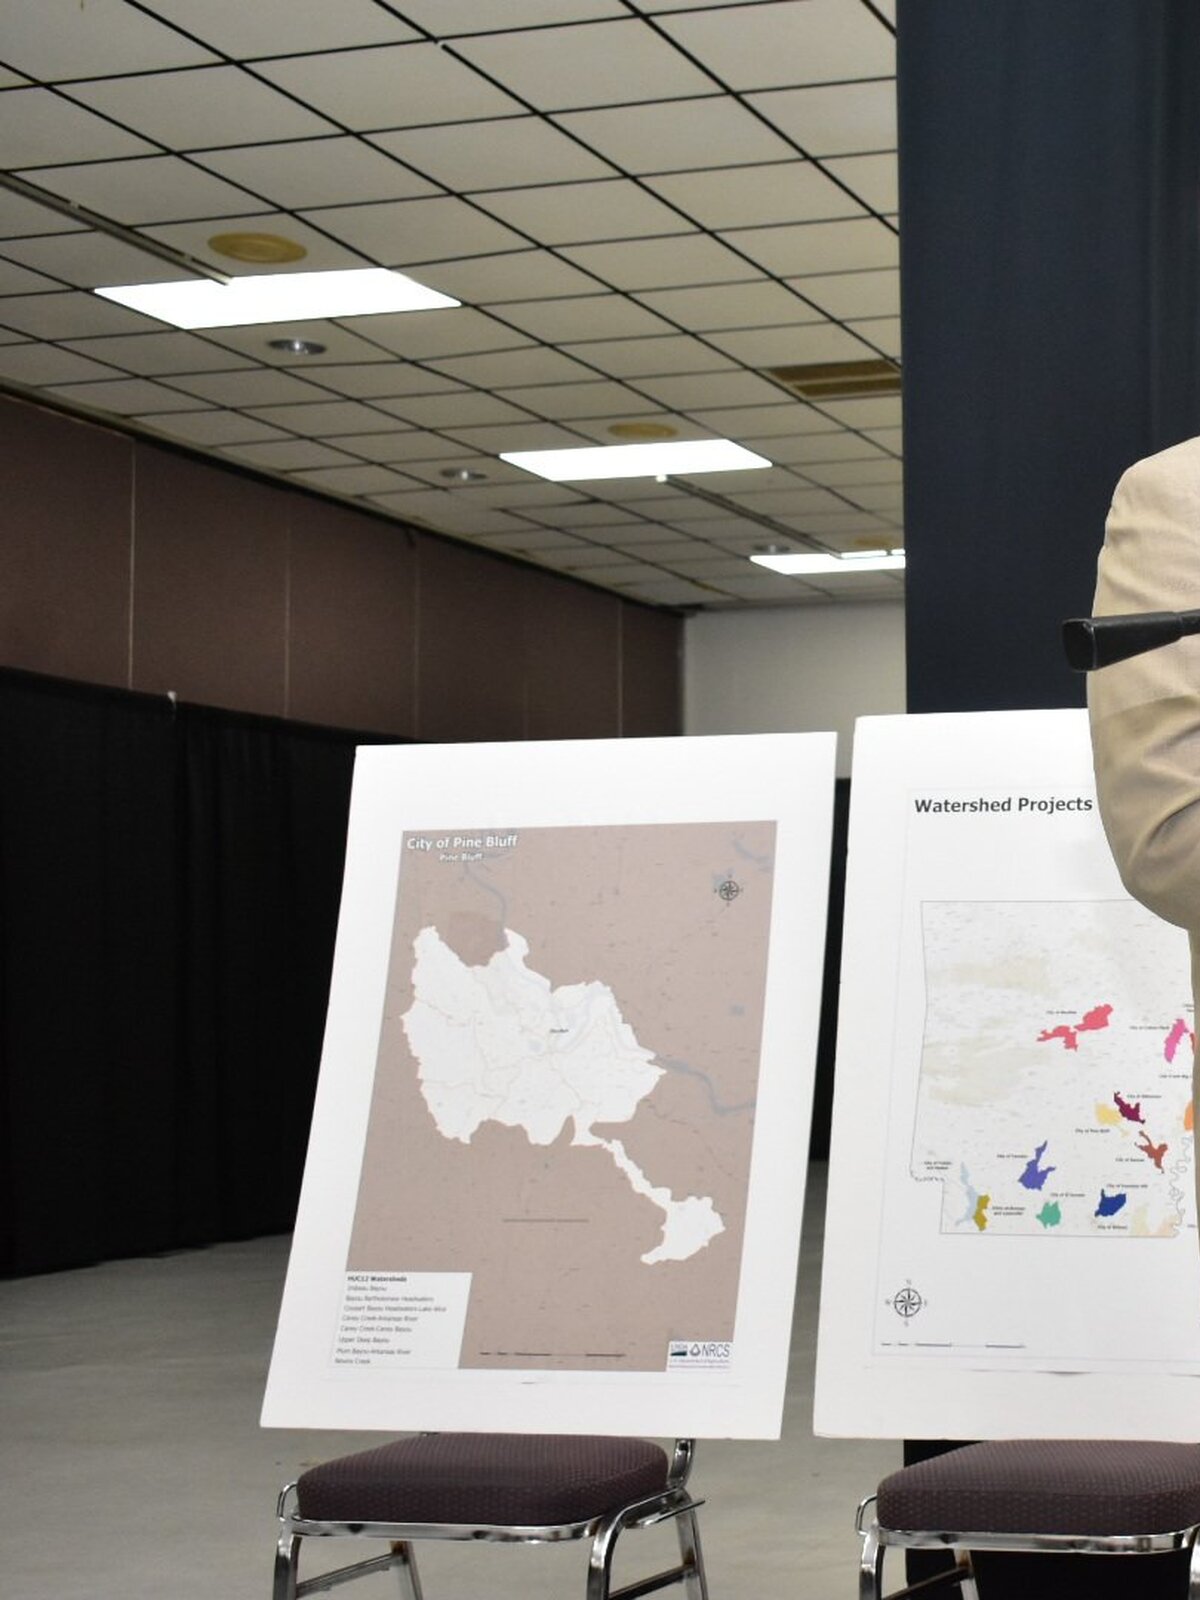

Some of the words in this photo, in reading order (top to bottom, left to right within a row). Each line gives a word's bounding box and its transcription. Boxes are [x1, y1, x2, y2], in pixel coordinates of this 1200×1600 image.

[914, 797, 1012, 813] Watershed
[1018, 797, 1093, 815] Projects
[406, 837, 432, 851] City
[436, 837, 450, 848] of
[453, 836, 482, 849] Pine
[486, 834, 518, 848] Bluff
[461, 852, 483, 862] Bluff
[701, 1343, 730, 1357] NRCS
